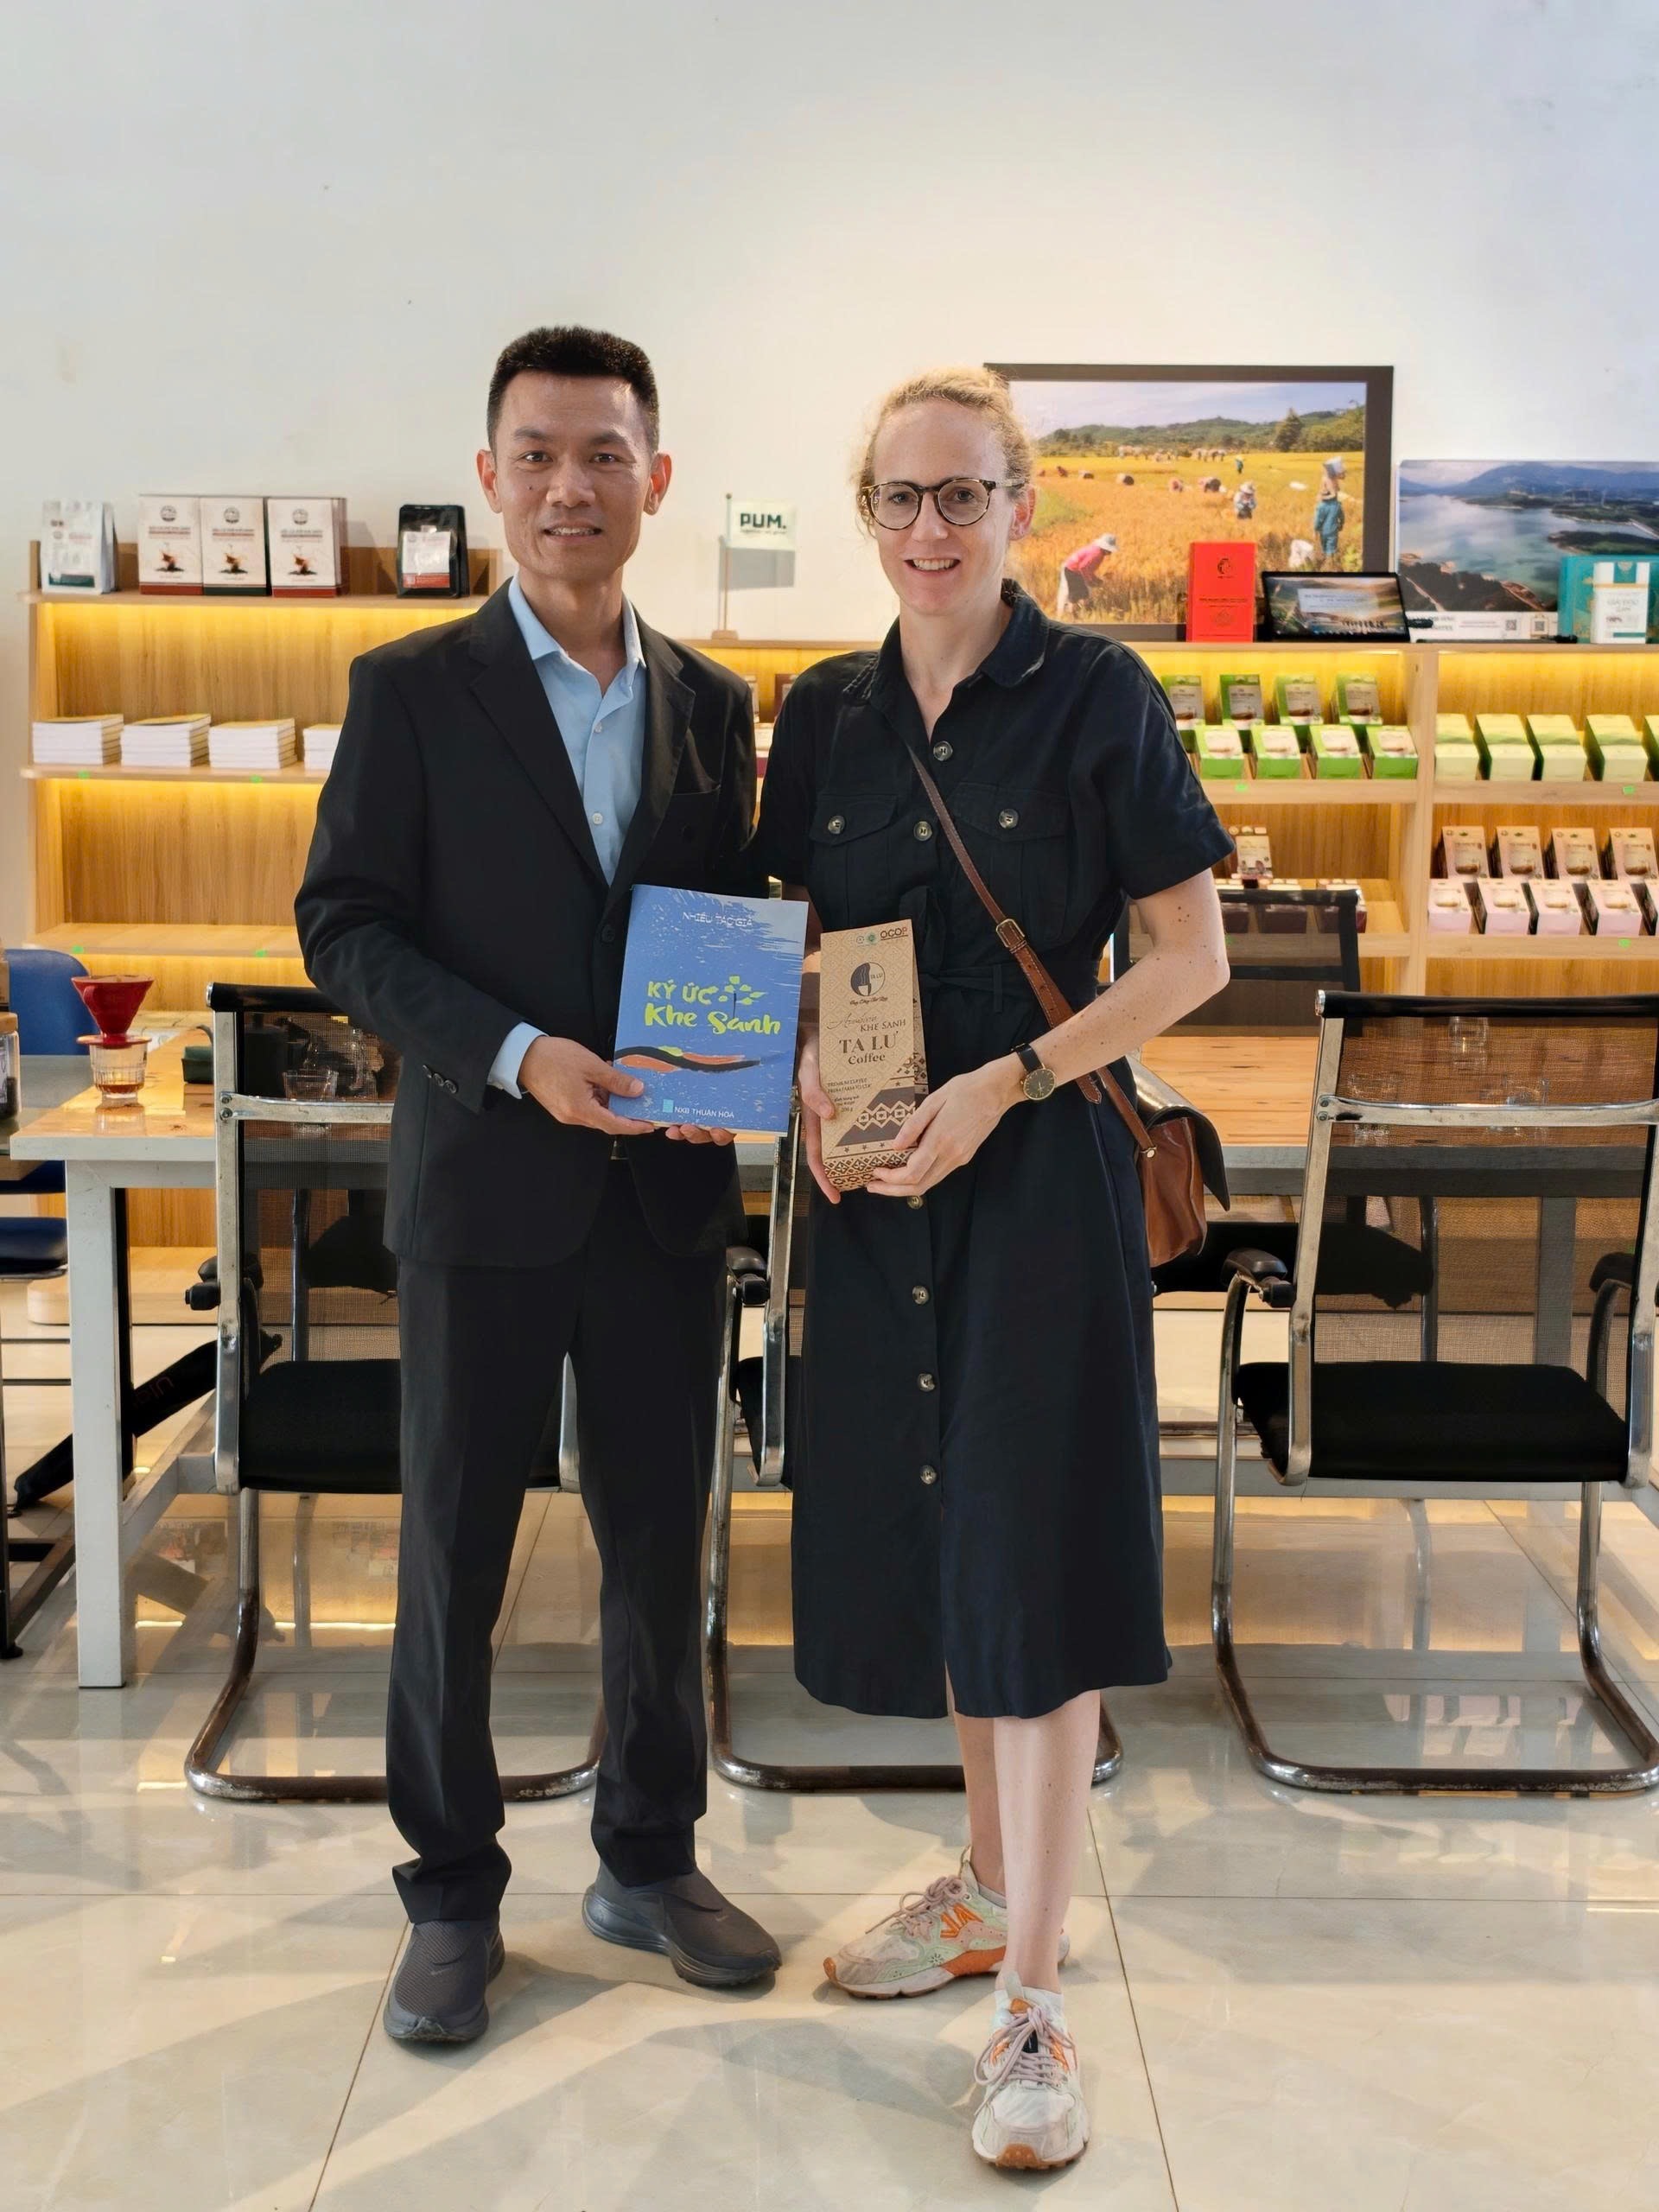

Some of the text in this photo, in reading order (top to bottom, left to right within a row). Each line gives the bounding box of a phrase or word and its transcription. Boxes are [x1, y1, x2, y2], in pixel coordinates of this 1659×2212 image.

[741, 512, 786, 529] PUM.
[880, 926, 908, 938] OCOP
[648, 979, 677, 1000] KÝ
[645, 1002, 781, 1035] Khe Sanh
[861, 1022, 879, 1032] KHE
[881, 1019, 906, 1030] SANH
[839, 1038, 864, 1053] TA
[848, 1053, 886, 1065] Coffee
